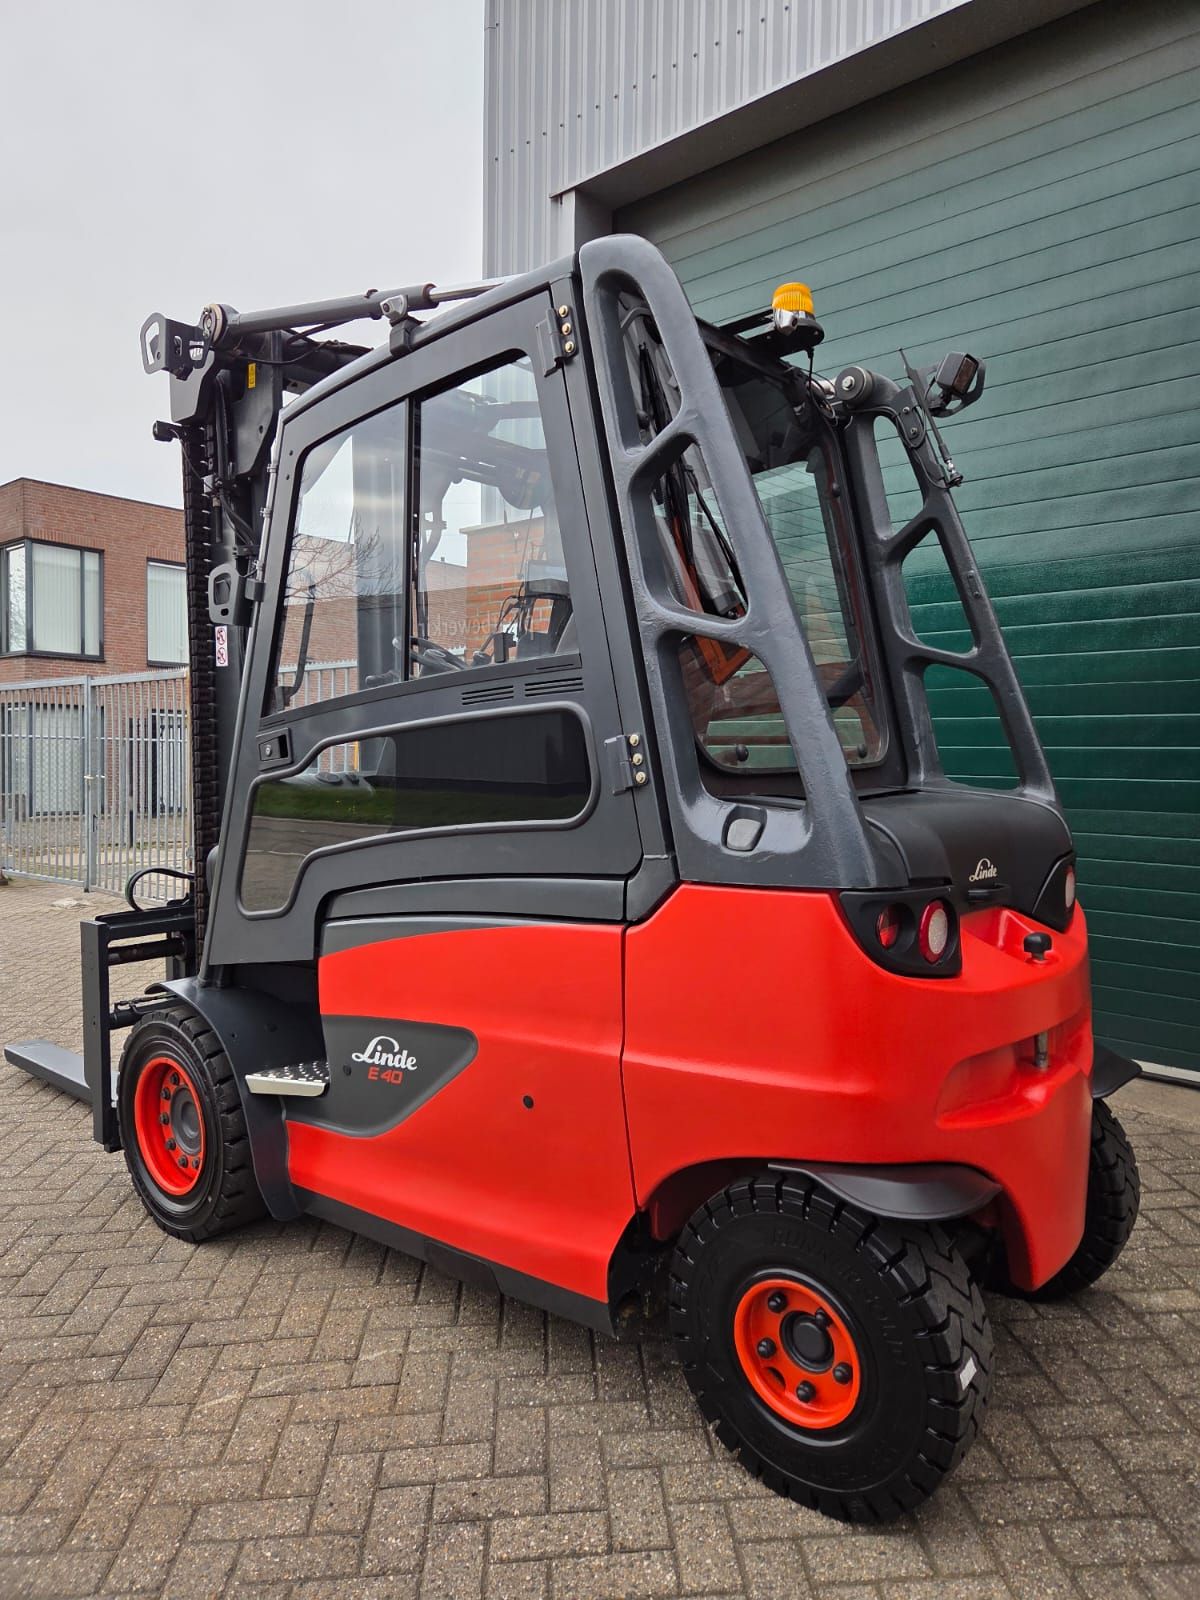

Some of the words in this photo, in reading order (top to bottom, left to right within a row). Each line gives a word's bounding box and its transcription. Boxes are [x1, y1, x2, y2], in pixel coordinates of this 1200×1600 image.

[968, 857, 998, 882] Linde
[351, 1035, 418, 1070] Linde
[367, 1066, 380, 1081] E
[381, 1069, 403, 1085] 40
